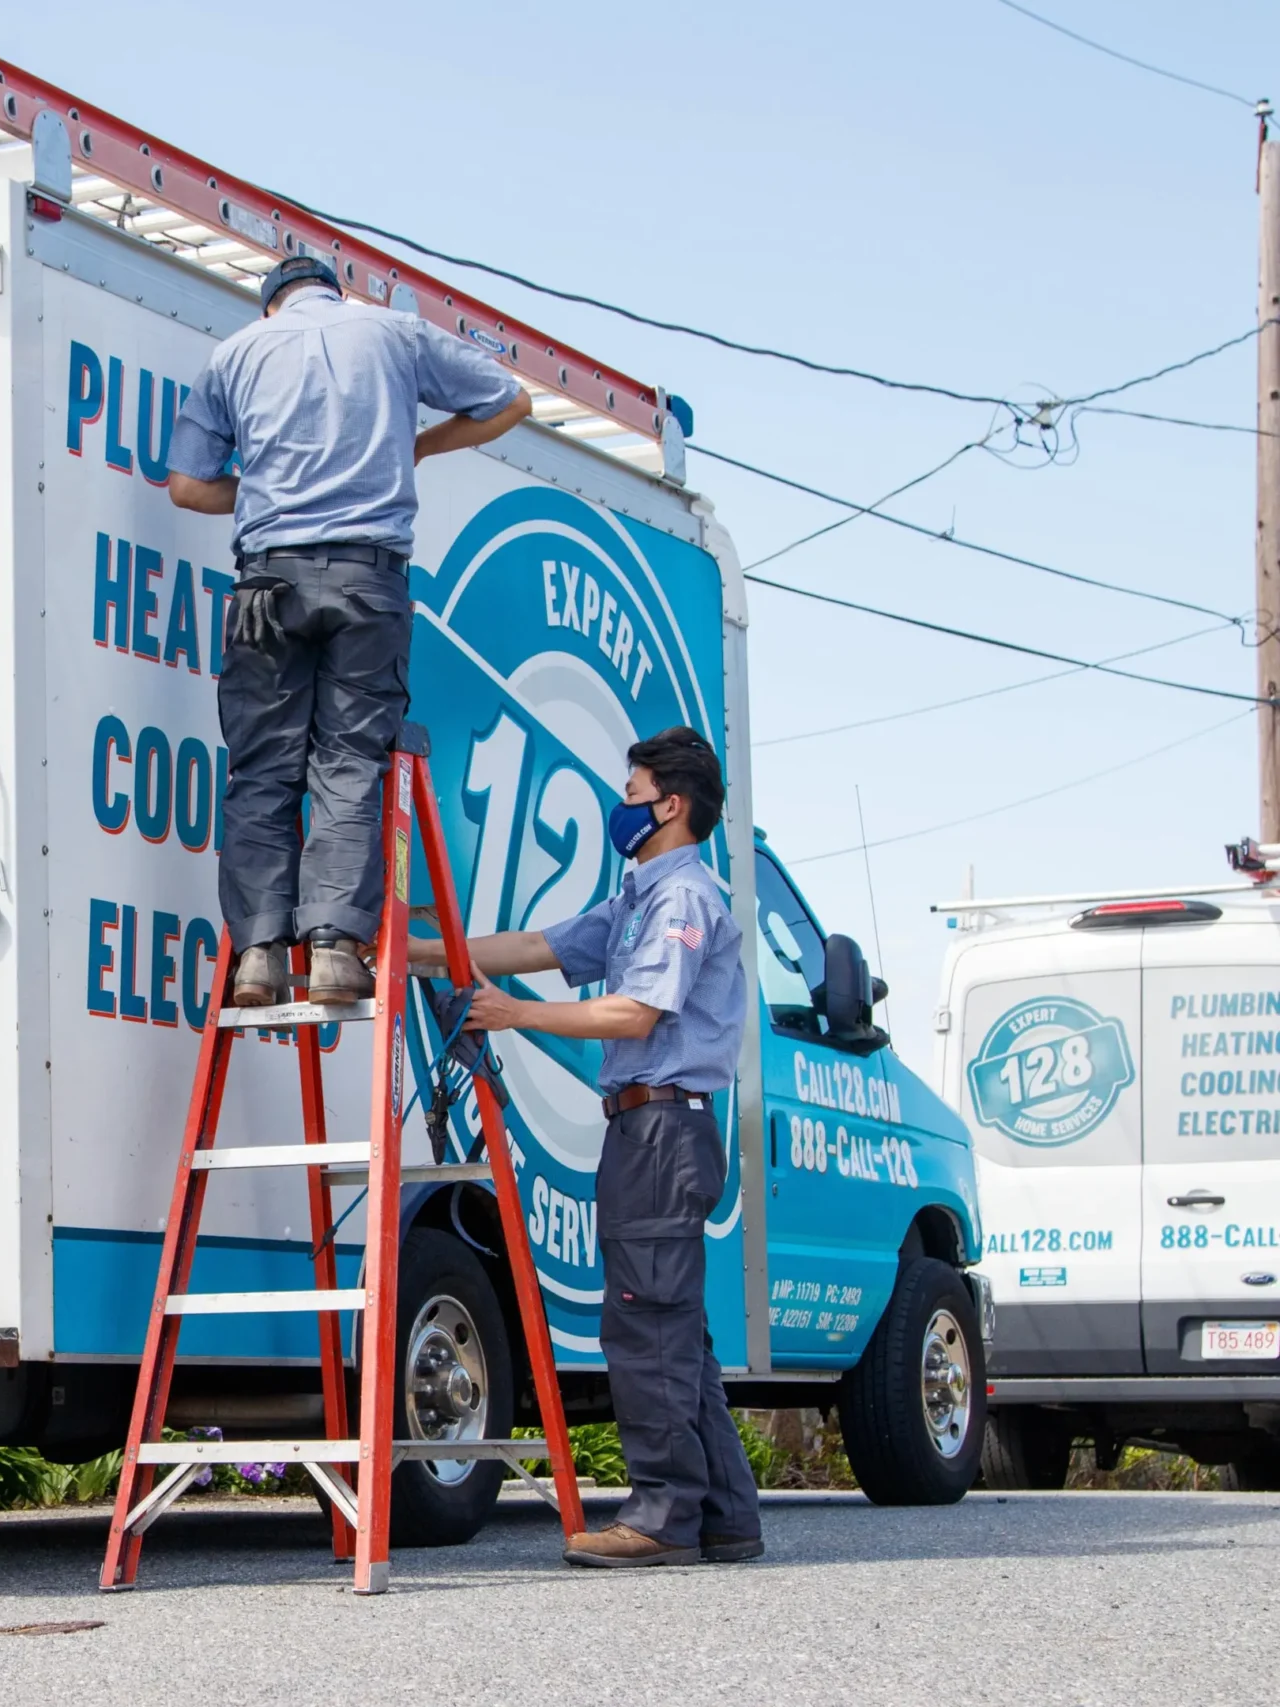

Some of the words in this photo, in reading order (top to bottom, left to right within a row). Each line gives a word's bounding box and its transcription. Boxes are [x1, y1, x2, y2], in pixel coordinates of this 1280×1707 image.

[541, 560, 653, 701] EXPERT
[1171, 991, 1280, 1019] PLUMBIN
[1009, 1008, 1058, 1034] EXPERT
[1000, 1035, 1094, 1105] 128
[1181, 1070, 1280, 1097] COOLIN
[1014, 1115, 1047, 1137] HOME
[1051, 1096, 1103, 1136] SERVICES
[1178, 1109, 1280, 1137] ELECTRI
[983, 1228, 1113, 1254] ALL128.COM
